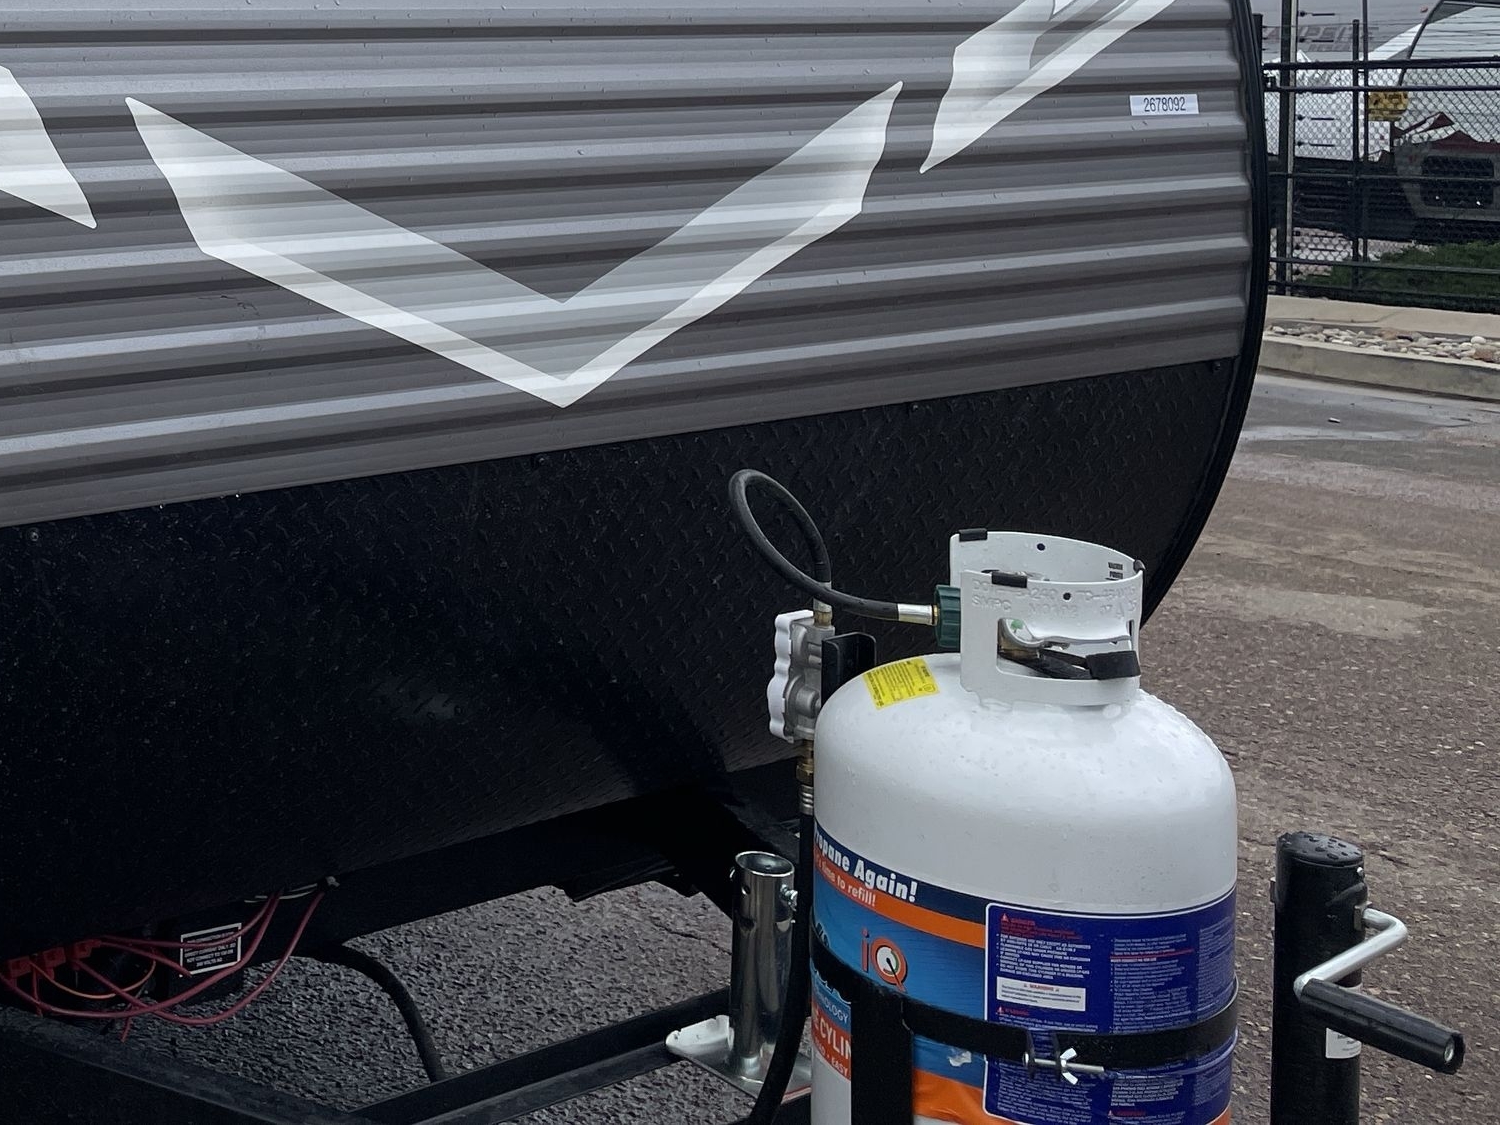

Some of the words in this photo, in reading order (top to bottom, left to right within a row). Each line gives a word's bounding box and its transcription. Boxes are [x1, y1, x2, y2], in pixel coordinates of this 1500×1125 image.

[1143, 97, 1186, 112] 2678092
[815, 830, 850, 872] ropane
[853, 859, 918, 903] Again!
[837, 875, 846, 889] to
[848, 886, 876, 908] refill!
[820, 1016, 852, 1060] CYLIN
[831, 1057, 849, 1076] EASY
